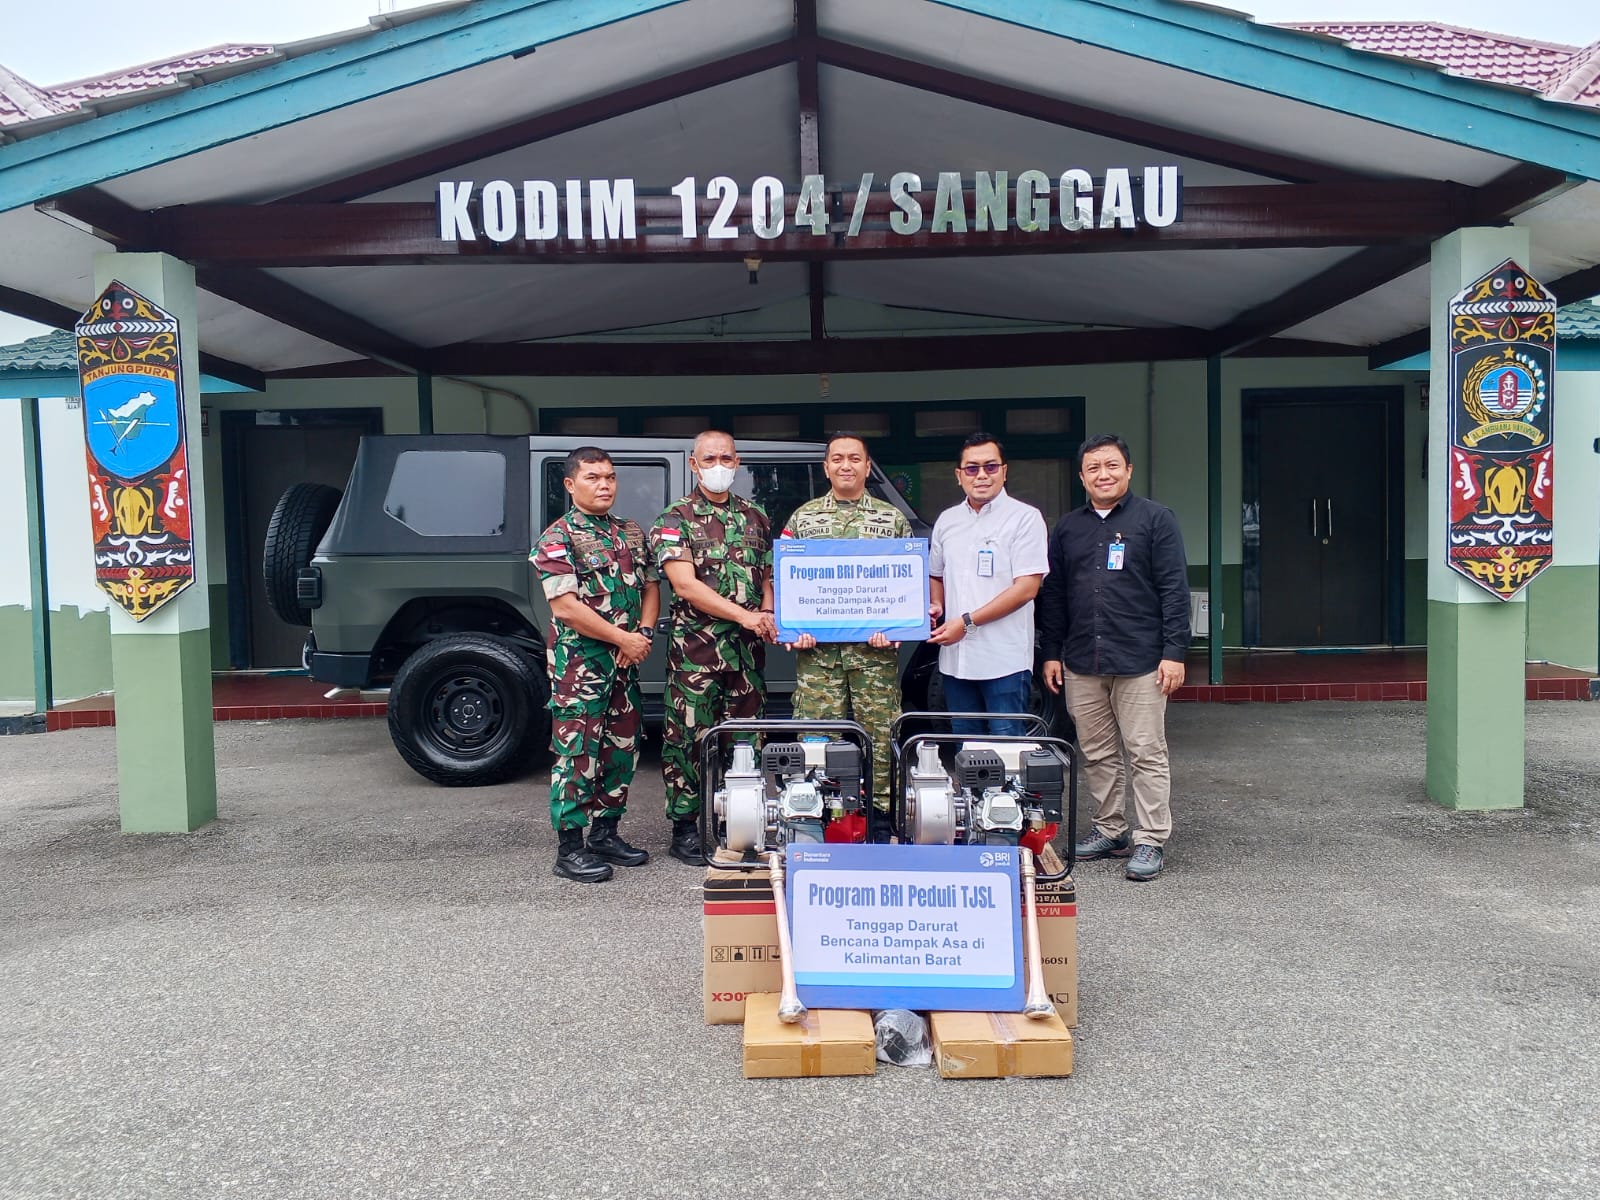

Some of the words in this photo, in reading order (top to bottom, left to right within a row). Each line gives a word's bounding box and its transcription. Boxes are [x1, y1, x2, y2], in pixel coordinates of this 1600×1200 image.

[438, 177, 637, 242] KODIM
[87, 364, 169, 381] TANJUNGPURA
[864, 526, 879, 534] TNI
[881, 528, 893, 537] AD
[790, 565, 835, 581] Program
[837, 565, 854, 579] BRI
[857, 564, 889, 579] Peduli
[891, 563, 913, 578] TJSL
[818, 586, 854, 596] Tanggap
[856, 585, 888, 593] Darurat
[799, 596, 836, 605] Bencana
[838, 595, 873, 605] Dampak
[875, 595, 896, 605] Asap
[898, 595, 906, 603] di
[816, 607, 864, 616] Kalimantan
[866, 606, 889, 615] Barat
[995, 852, 1010, 861] BRI
[1036, 884, 1060, 892] Pom
[809, 883, 876, 909] Program
[880, 883, 903, 907] BRI
[908, 884, 956, 908] Peduli
[961, 885, 996, 909] TJSL
[1036, 907, 1061, 916] MA
[847, 919, 904, 934] Tanggap
[908, 919, 959, 932] Darurat
[820, 936, 879, 948] Bencana
[883, 936, 938, 951] Dampak
[943, 937, 968, 949] Asa
[972, 937, 985, 950] di
[844, 953, 921, 966] Kalimantan
[925, 953, 962, 966] Barat
